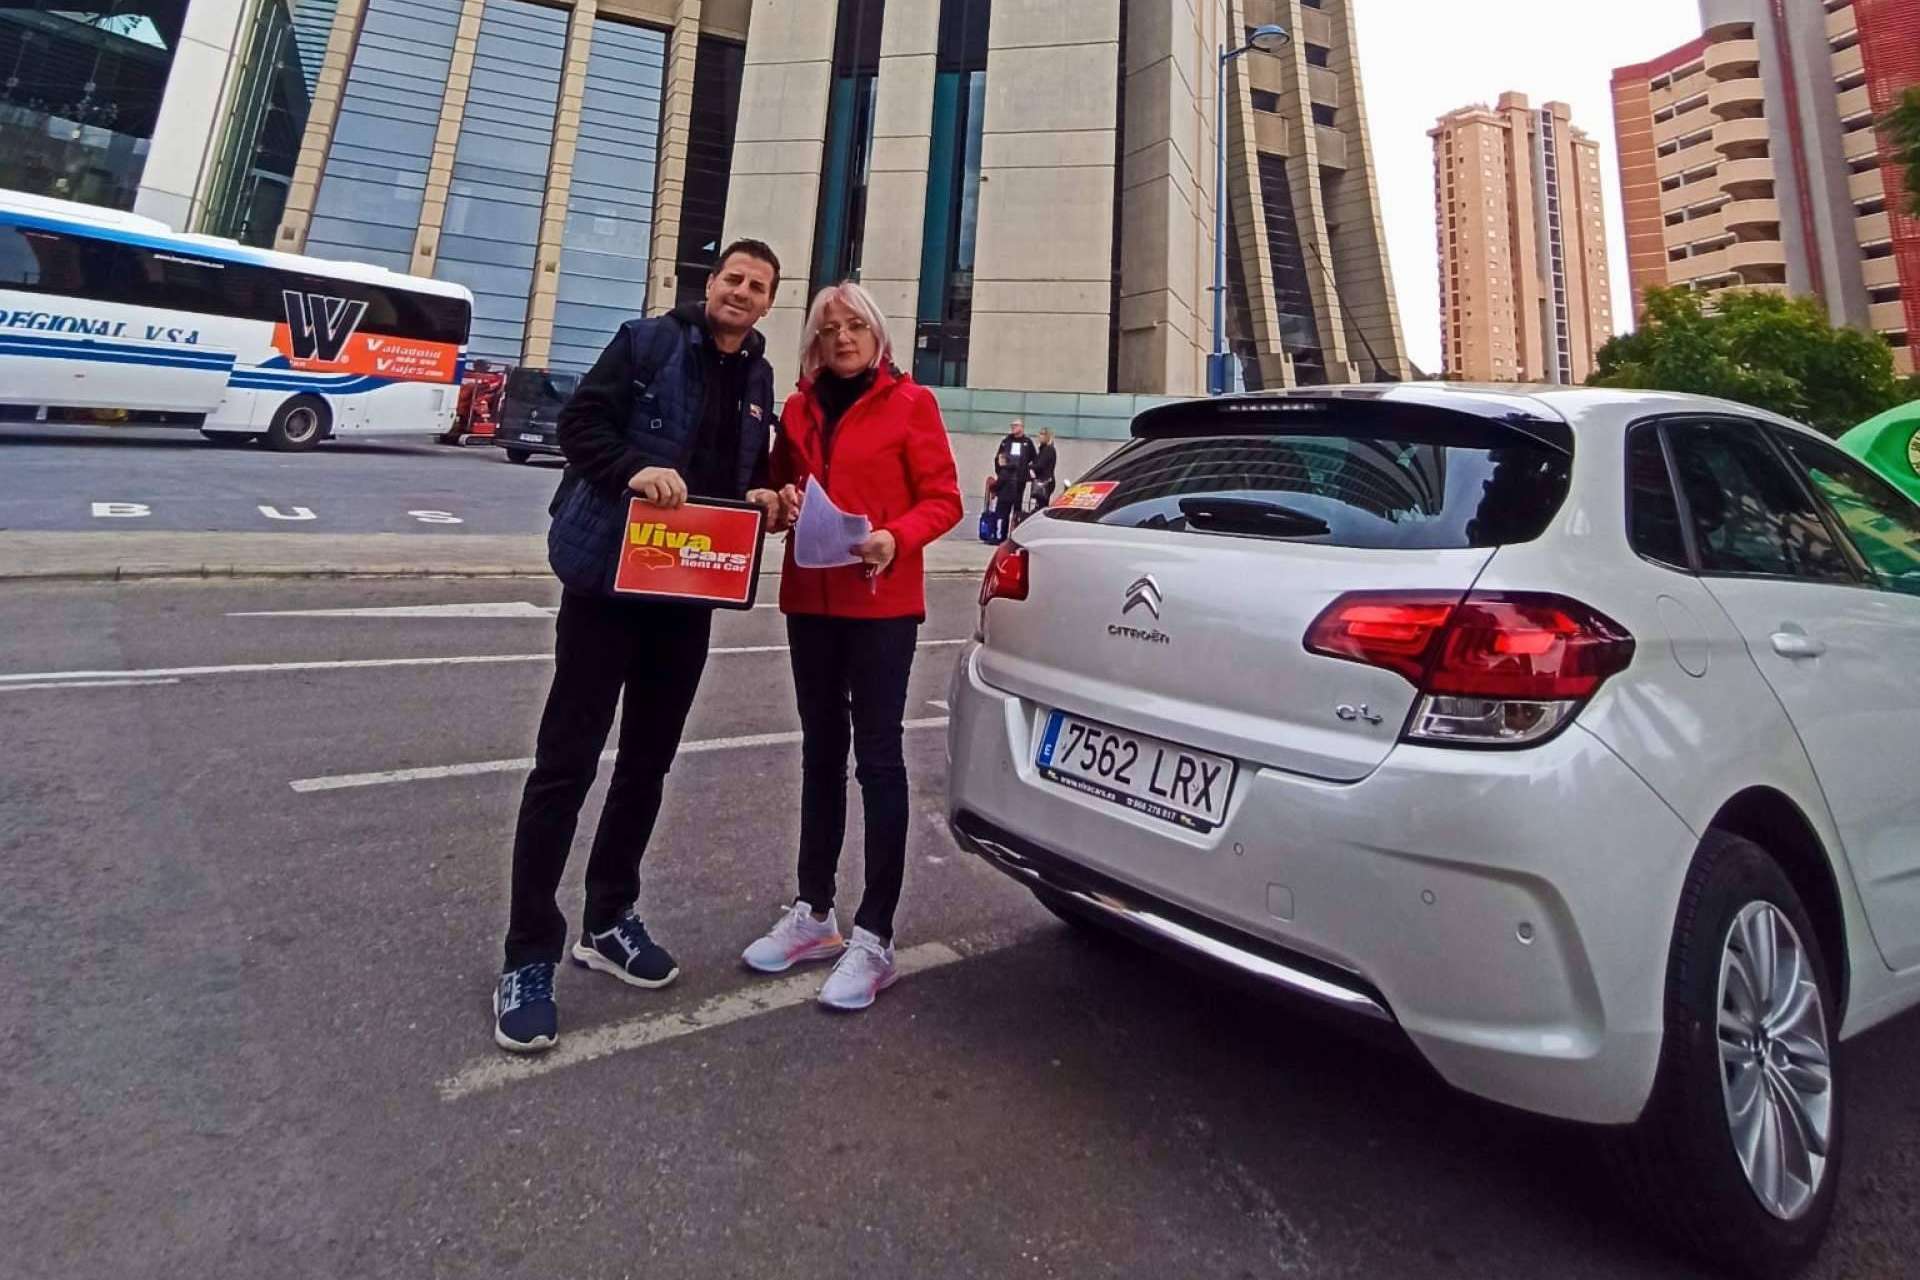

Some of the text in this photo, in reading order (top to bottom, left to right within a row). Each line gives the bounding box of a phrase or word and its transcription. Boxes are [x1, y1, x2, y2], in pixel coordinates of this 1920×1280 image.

[366, 337, 443, 359] Valladolid
[629, 521, 712, 552] Viva
[679, 545, 747, 565] Cars
[680, 558, 712, 570] Rent
[723, 561, 746, 573] Car
[1335, 703, 1384, 727] C4
[1060, 723, 1222, 812] 7562 LRX
